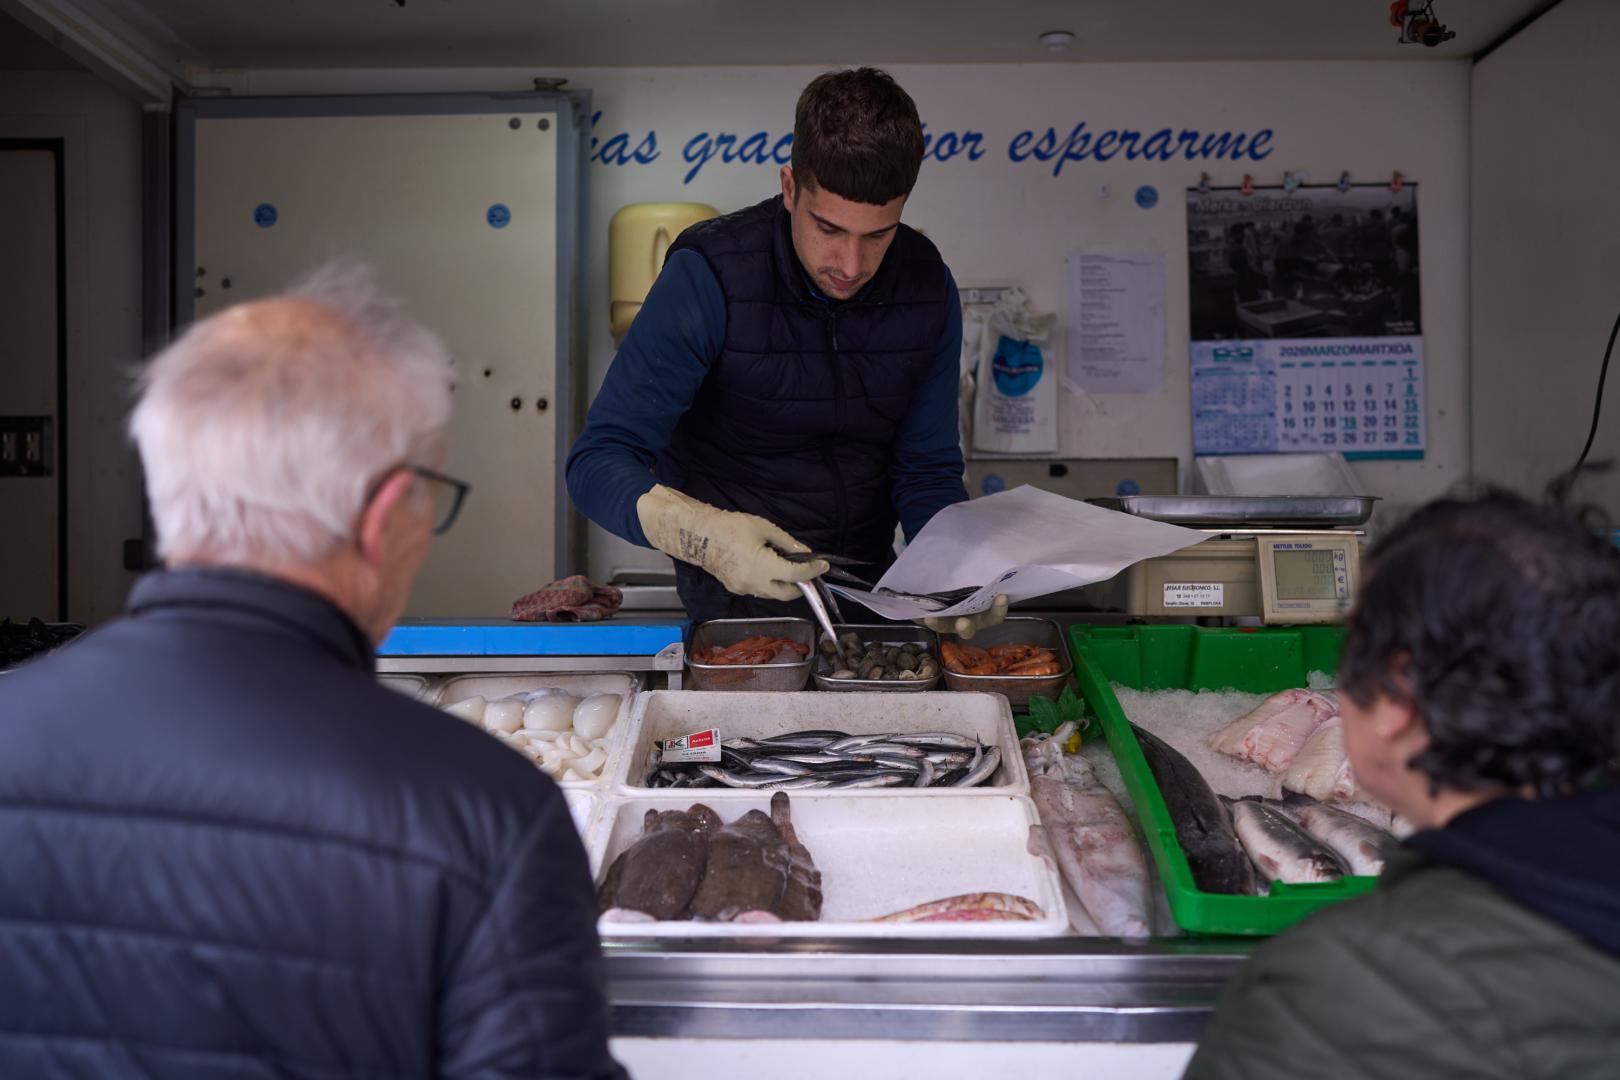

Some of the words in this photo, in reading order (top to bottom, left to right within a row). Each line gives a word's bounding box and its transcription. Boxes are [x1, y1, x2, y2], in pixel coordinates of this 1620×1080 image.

[683, 131, 796, 185] grac
[1008, 121, 1275, 177] esperarme
[1284, 384, 1292, 397] 2
[1305, 384, 1313, 397] 3
[1324, 384, 1333, 396] 4
[1345, 383, 1353, 396] 5
[1365, 383, 1373, 396] 6
[1385, 382, 1393, 395] 7
[1284, 400, 1293, 413] 9
[1302, 400, 1316, 412] 10
[1344, 400, 1357, 412] 12
[1364, 399, 1377, 411] 13
[1384, 399, 1397, 411] 14
[1405, 399, 1418, 412] 15
[1283, 417, 1296, 429] 16
[1303, 416, 1316, 428] 17
[1323, 416, 1336, 428] 18
[1363, 415, 1378, 428] 20
[1383, 415, 1397, 427] 21
[1405, 415, 1419, 428] 22
[1344, 432, 1357, 444] 26
[1364, 431, 1377, 443] 27
[1384, 431, 1398, 443] 28
[1333, 551, 1344, 562] kg
[1337, 576, 1345, 584] €
